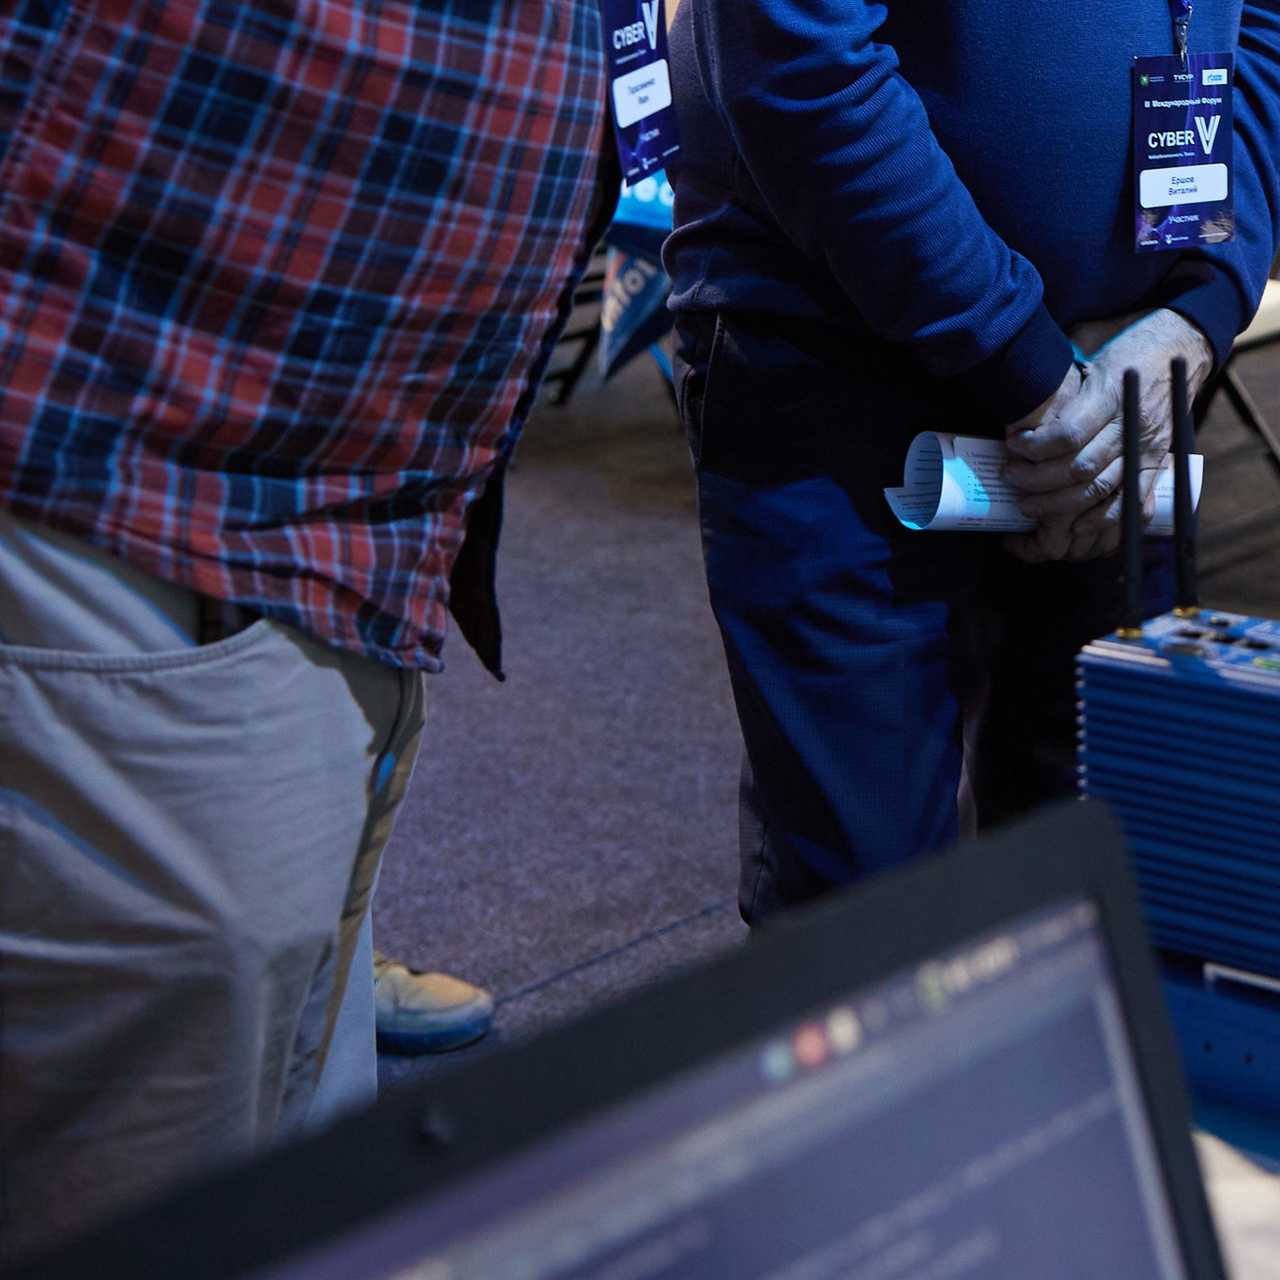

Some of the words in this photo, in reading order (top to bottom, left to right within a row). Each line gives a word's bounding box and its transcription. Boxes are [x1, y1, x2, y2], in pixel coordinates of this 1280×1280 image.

[613, 21, 645, 50] CYBER
[1201, 96, 1222, 106] Форум
[1148, 131, 1194, 148] CYBER
[1194, 115, 1220, 154] V
[1171, 176, 1195, 186] Ершов
[1168, 185, 1198, 196] Виталий
